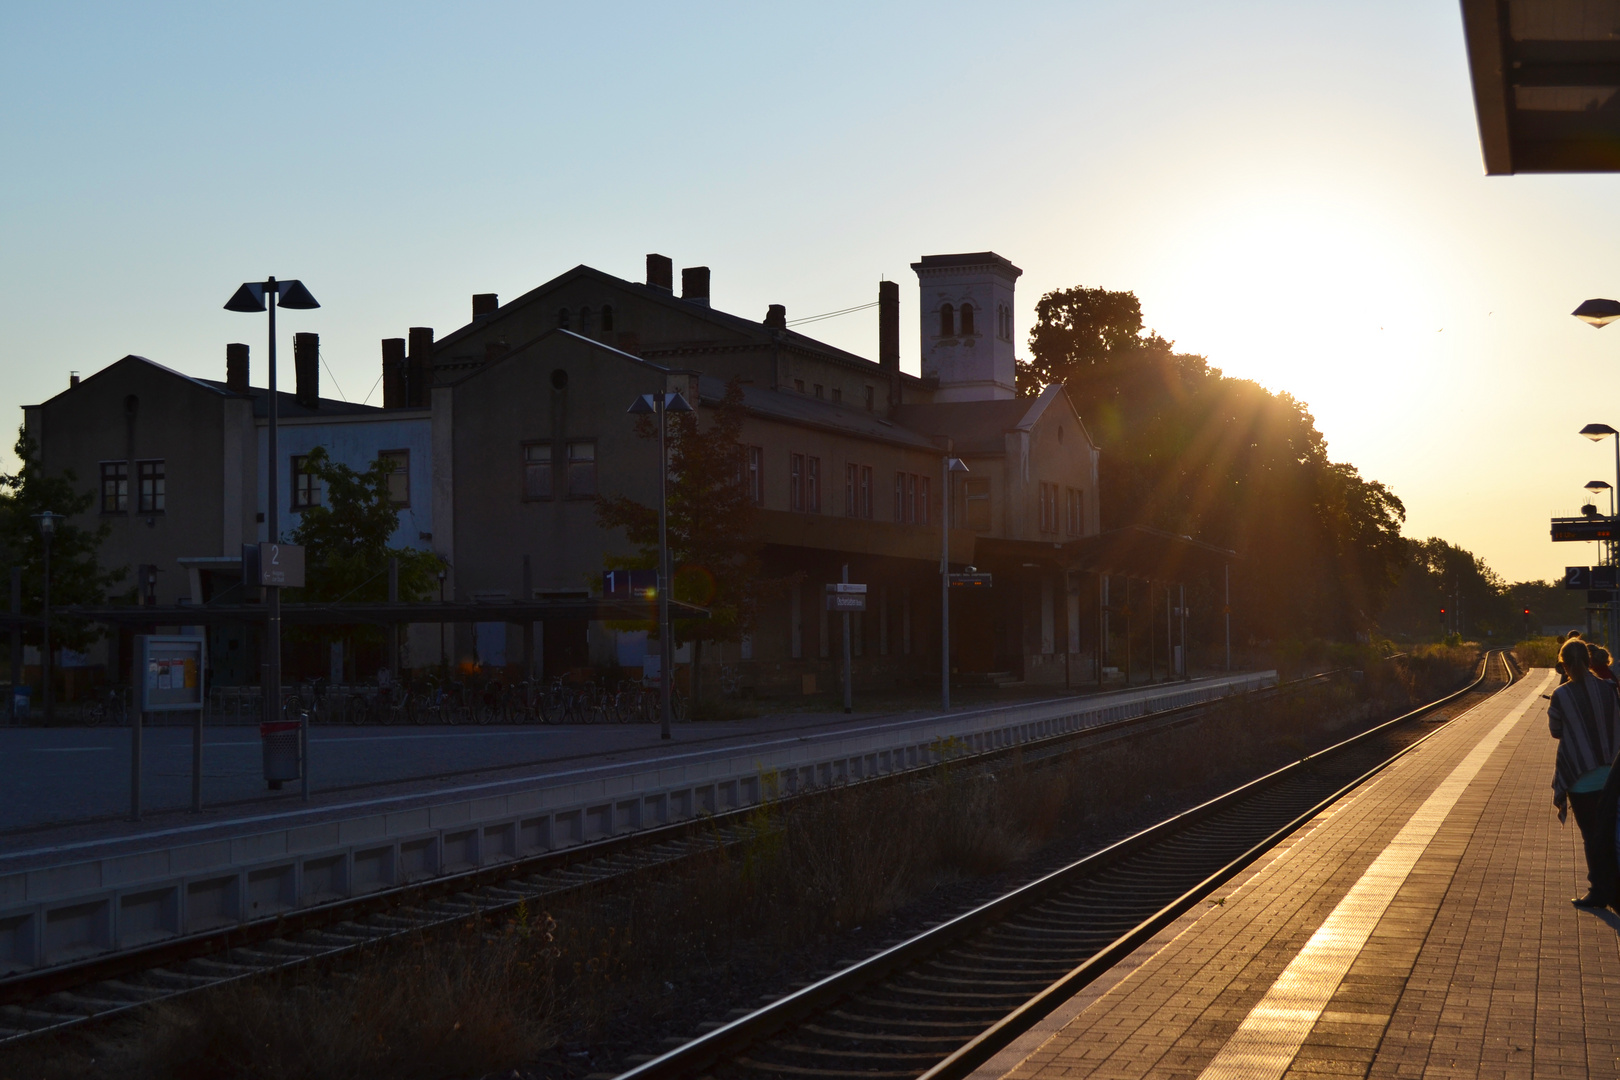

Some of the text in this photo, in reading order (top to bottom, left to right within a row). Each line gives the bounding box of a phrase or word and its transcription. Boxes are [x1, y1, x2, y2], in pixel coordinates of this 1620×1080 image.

[272, 545, 279, 565] 2
[606, 571, 615, 593] 1
[1569, 568, 1581, 584] 2
